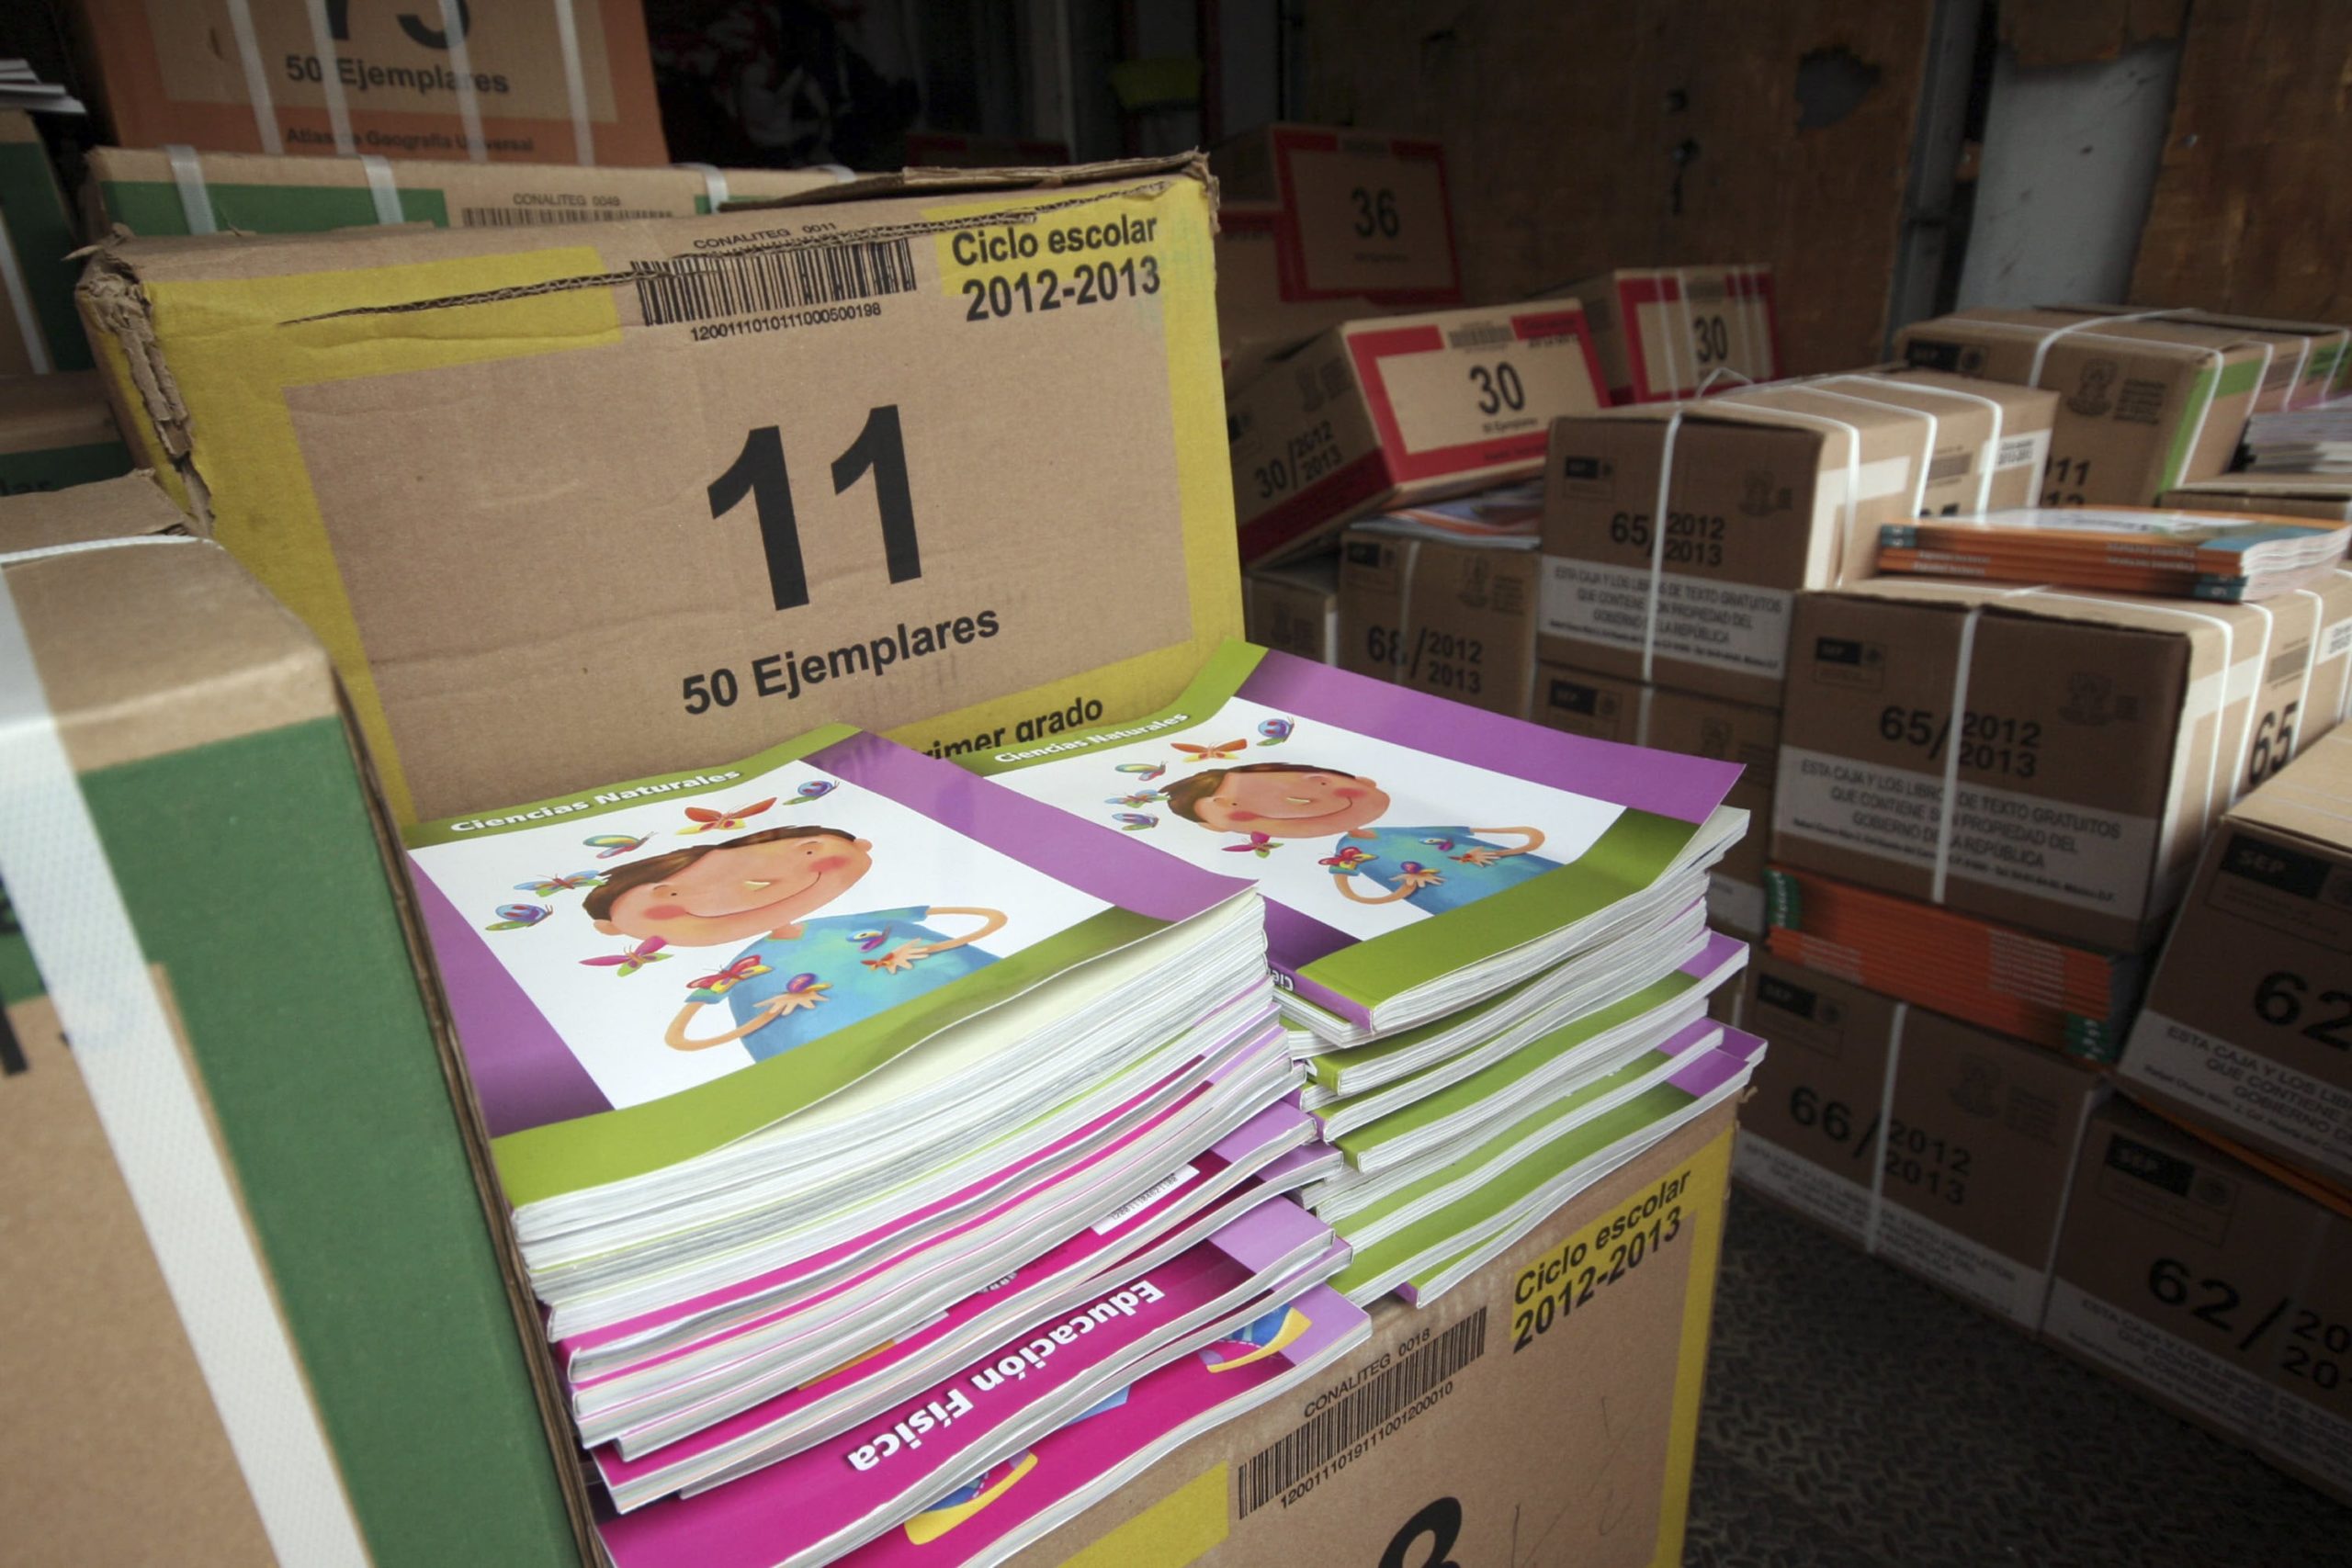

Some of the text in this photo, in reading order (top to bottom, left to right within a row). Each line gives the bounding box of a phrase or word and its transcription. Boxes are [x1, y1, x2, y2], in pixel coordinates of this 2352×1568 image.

[285, 54, 510, 95] 50 Ejemplaes
[455, 132, 535, 152] Uversal
[513, 193, 586, 207] CONALITEG
[1350, 186, 1402, 238] 36
[693, 222, 837, 249] CONALITEG 0011
[952, 214, 1159, 266] Ciclo escolar
[962, 254, 1161, 321] 2012-2013
[1693, 316, 1728, 362] 30
[1468, 362, 1525, 414] 30
[707, 404, 922, 609] 11
[1665, 512, 1725, 540] 2012
[1662, 539, 1723, 568] 2013
[682, 609, 1001, 716] 50 Ejemplares
[1428, 629, 1483, 665] 2012
[1427, 660, 1482, 694] 2013
[922, 696, 1103, 760] imer grado
[993, 712, 1191, 764] Ciencias Naturales
[1962, 710, 2042, 749] 2012
[2250, 699, 2300, 784] 65
[1958, 740, 2038, 779] 2013
[449, 768, 742, 834] Ciencias Naturales
[1906, 780, 1944, 802] LIBRO
[2238, 848, 2286, 873] SEP
[2255, 969, 2352, 1053] 62
[2165, 1024, 2209, 1053] ESTA
[2212, 1042, 2259, 1074] CAJA
[2277, 1068, 2317, 1097] LOS
[2205, 1055, 2341, 1126] QUE CONTIENE
[1888, 1118, 1972, 1178] 2012
[1883, 1149, 1966, 1206] 2013
[1513, 1243, 1588, 1306] Ciclo
[1594, 1169, 1692, 1253] escolar
[1512, 1206, 1683, 1355] 2012-2013
[974, 1278, 1166, 1396] Educación
[1304, 1327, 1430, 1418] CONALITEG 0018
[847, 1373, 976, 1474] Física
